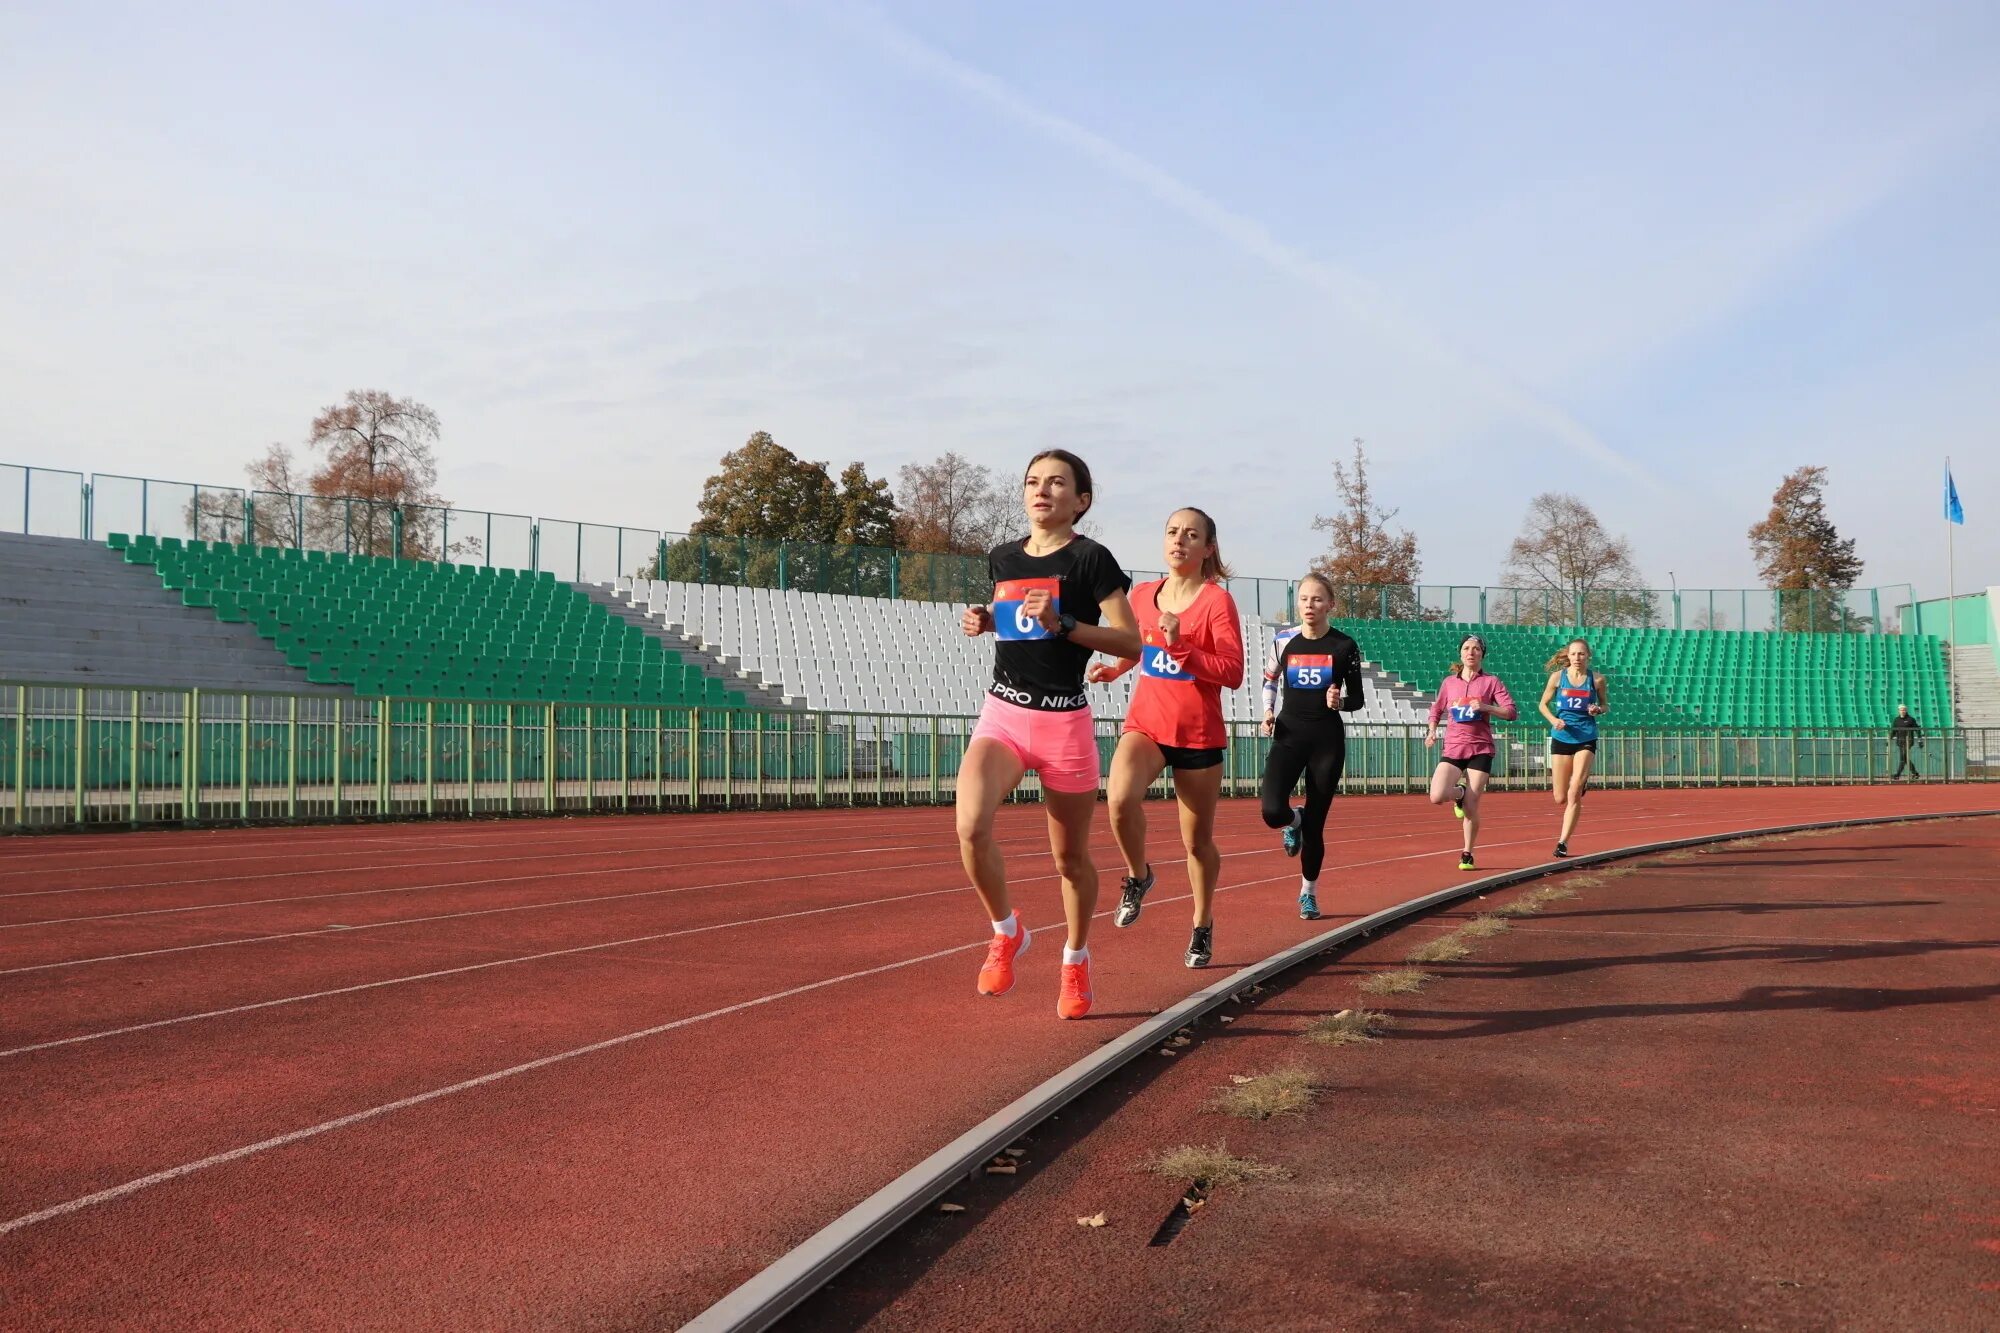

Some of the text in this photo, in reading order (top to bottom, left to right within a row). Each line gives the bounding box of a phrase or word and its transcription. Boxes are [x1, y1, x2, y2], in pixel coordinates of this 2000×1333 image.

[1015, 603, 1034, 633] 6
[1151, 650, 1182, 675] 48
[1297, 668, 1322, 686] 55
[993, 682, 1086, 708] PRO NIKE
[1566, 697, 1582, 709] 12
[1456, 706, 1475, 719] 74
